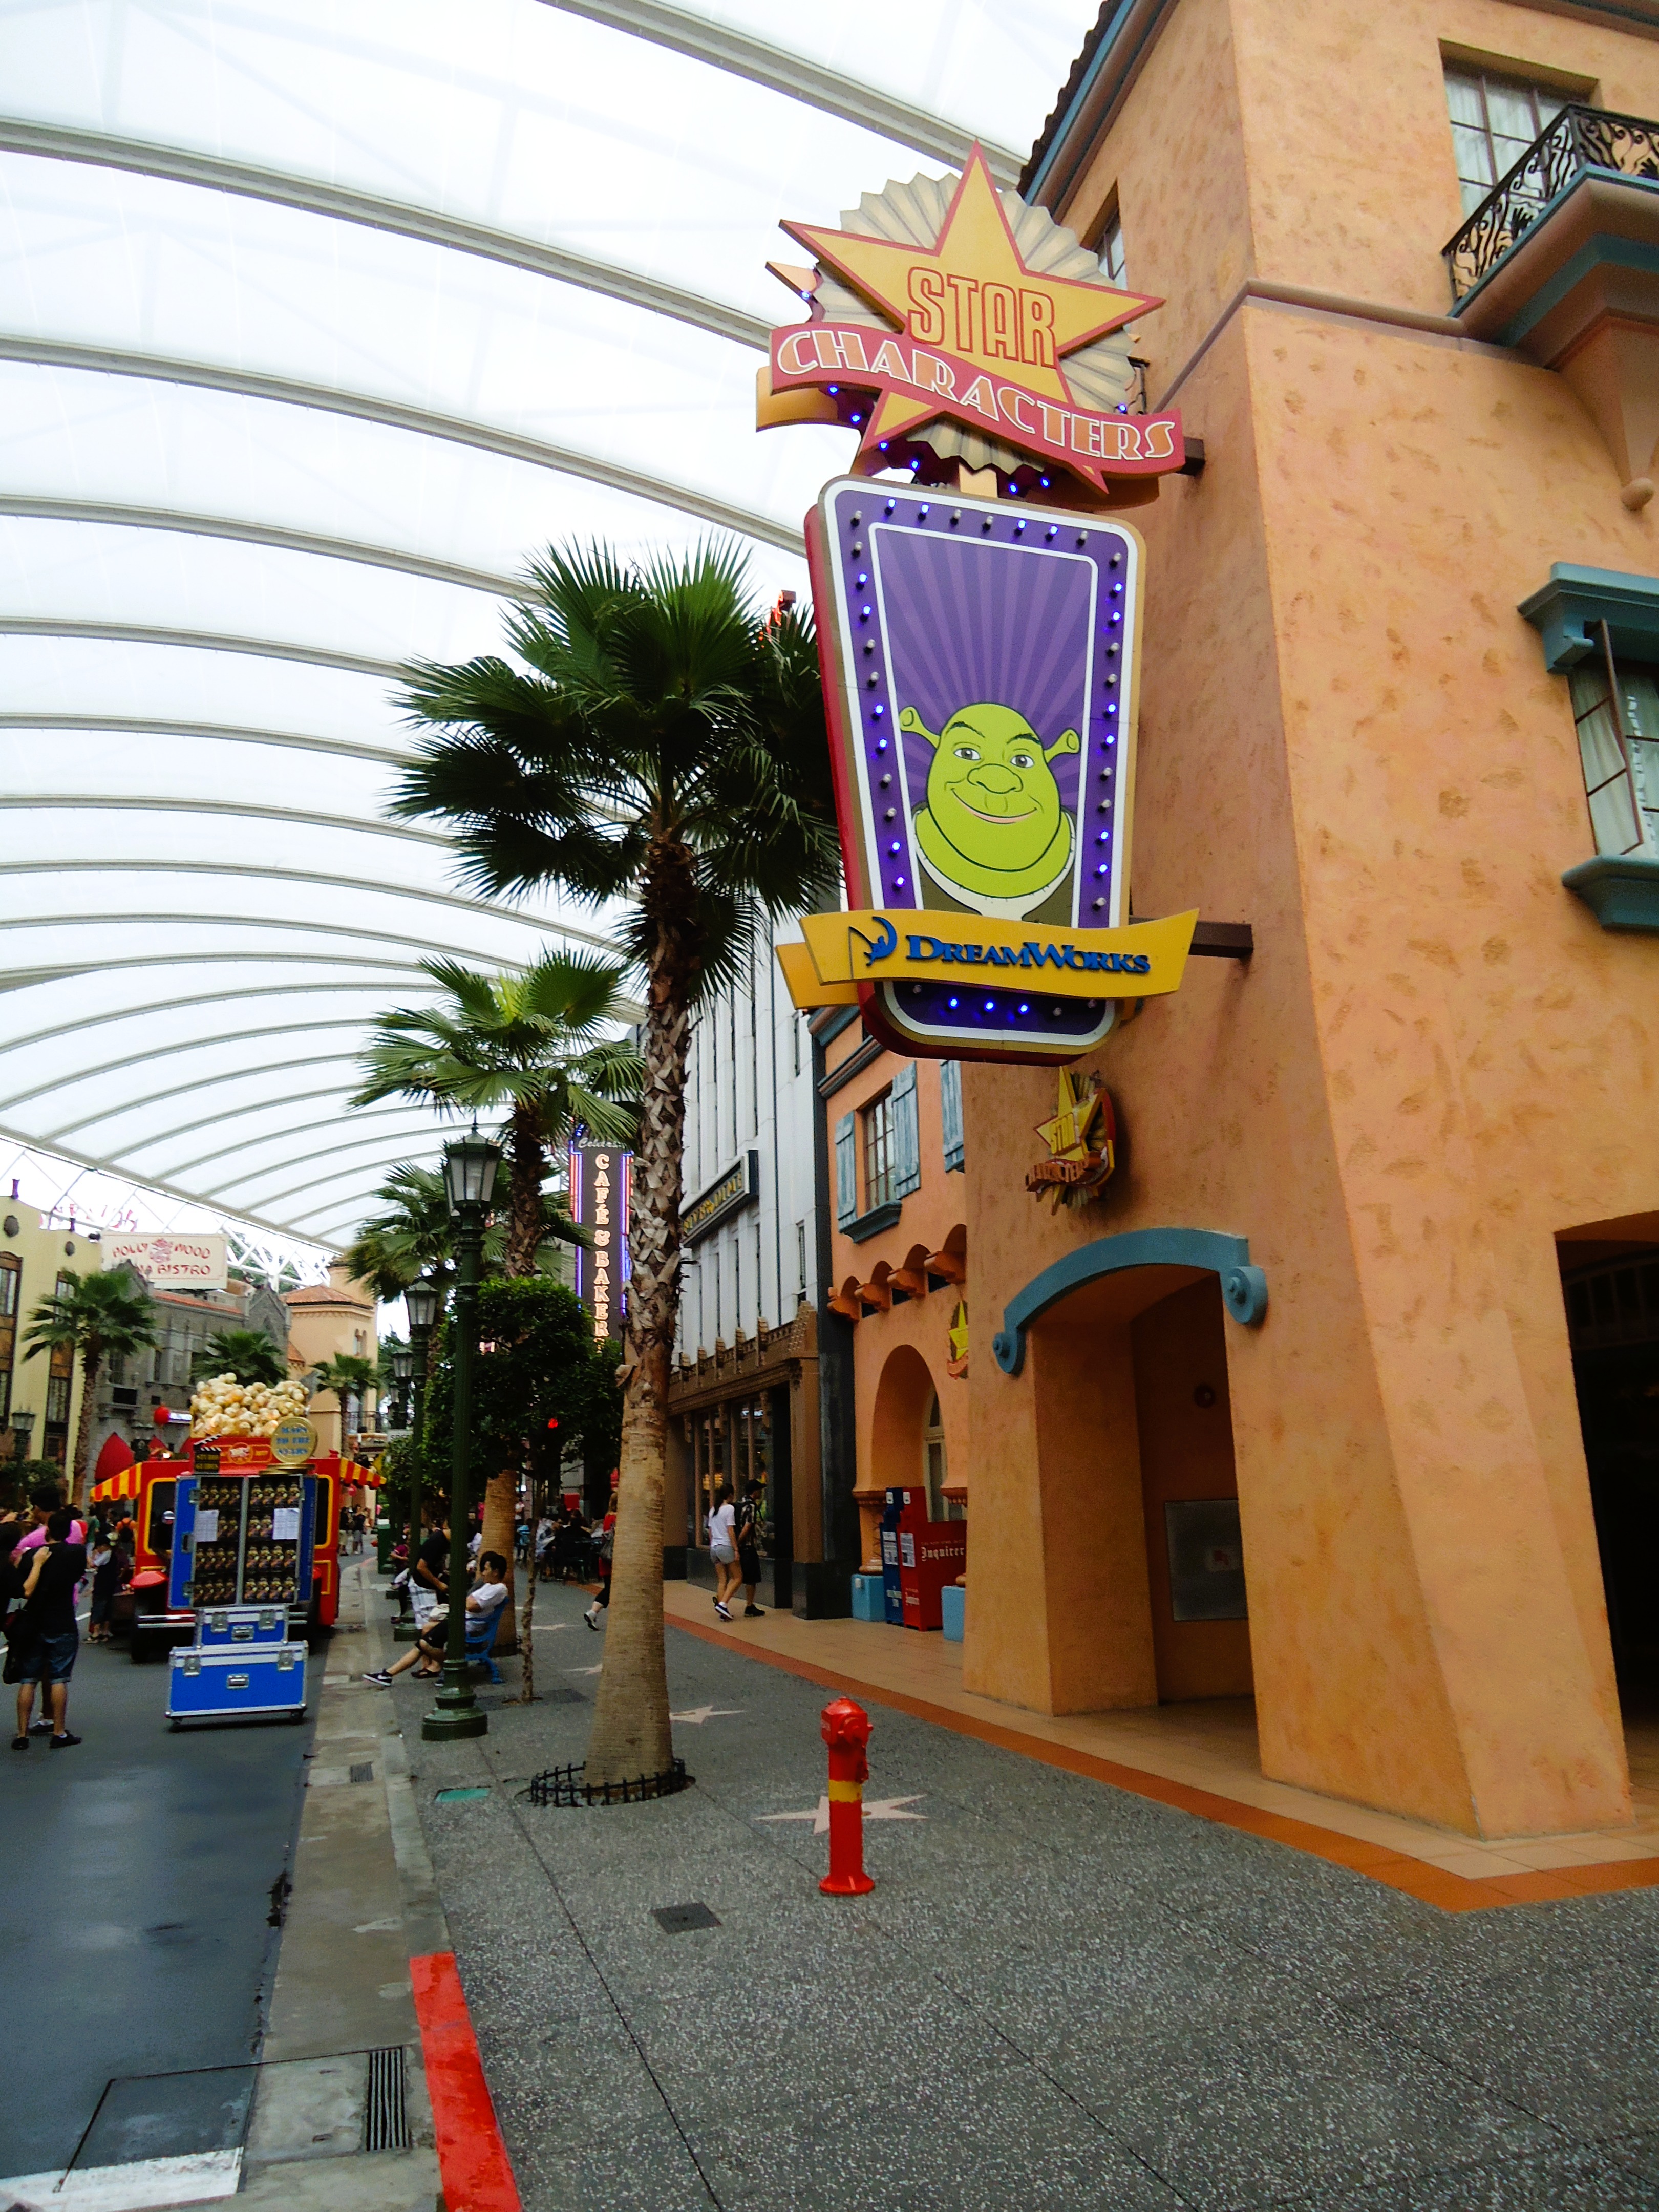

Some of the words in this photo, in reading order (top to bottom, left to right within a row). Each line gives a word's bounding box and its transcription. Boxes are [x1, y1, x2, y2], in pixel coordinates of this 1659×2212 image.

[907, 266, 1057, 369] STAR
[776, 330, 1176, 461] CHARACTERS
[593, 1153, 610, 1225] CAFÉ
[593, 1230, 611, 1247] &
[157, 1264, 211, 1275] BISTRO
[921, 1546, 964, 1562] Inquirer
